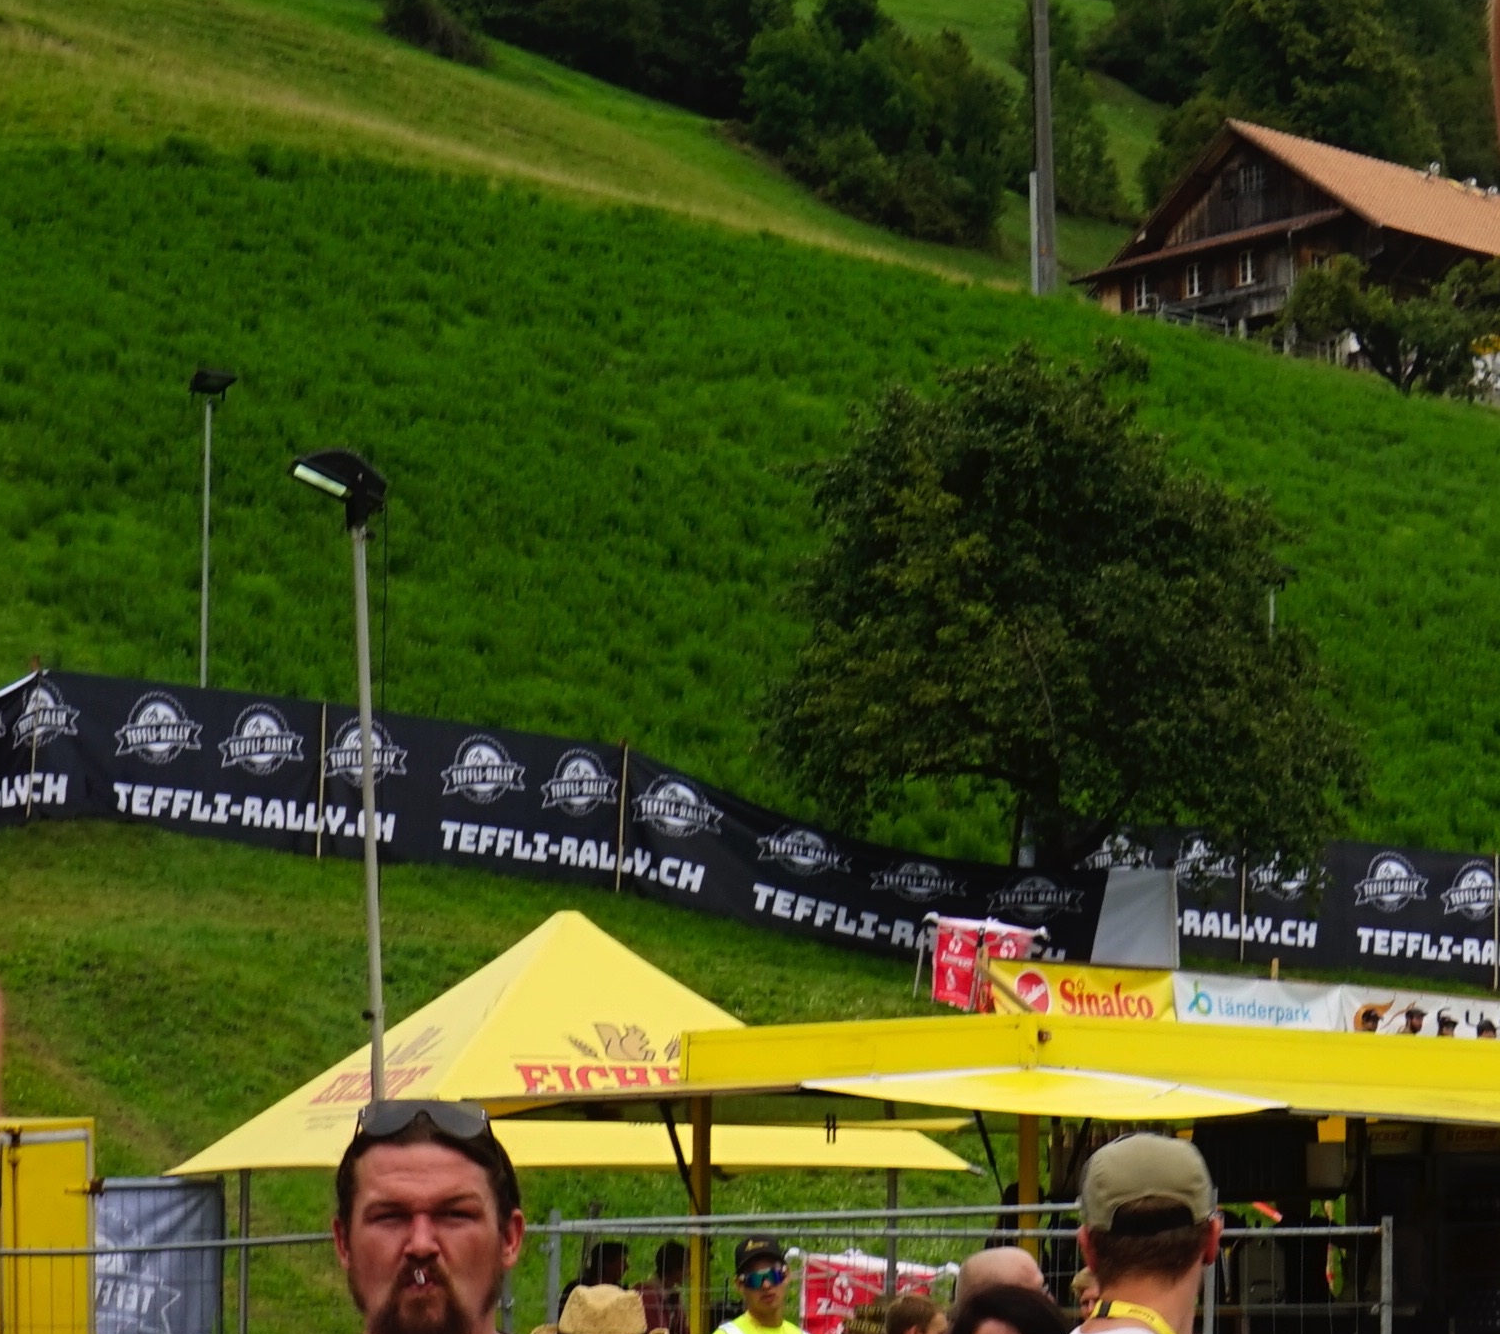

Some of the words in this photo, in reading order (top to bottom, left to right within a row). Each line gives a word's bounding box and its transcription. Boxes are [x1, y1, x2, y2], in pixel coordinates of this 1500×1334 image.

[127, 724, 191, 743] TEFFLI-RALLY
[228, 735, 293, 756] TEFFLI-RALLY
[451, 768, 515, 785] TEFFLI-RALLY
[550, 780, 610, 799] TEFFLI-RALLY
[640, 800, 711, 824] TEFFLI-RALLY
[768, 839, 841, 866] TEFFLI-RALLY
[883, 872, 957, 893] TEFFLI-RALLY
[1363, 878, 1420, 894] TEFFLI-RALLY
[1059, 977, 1155, 1019] Sinalco
[1217, 995, 1312, 1025] länderpark
